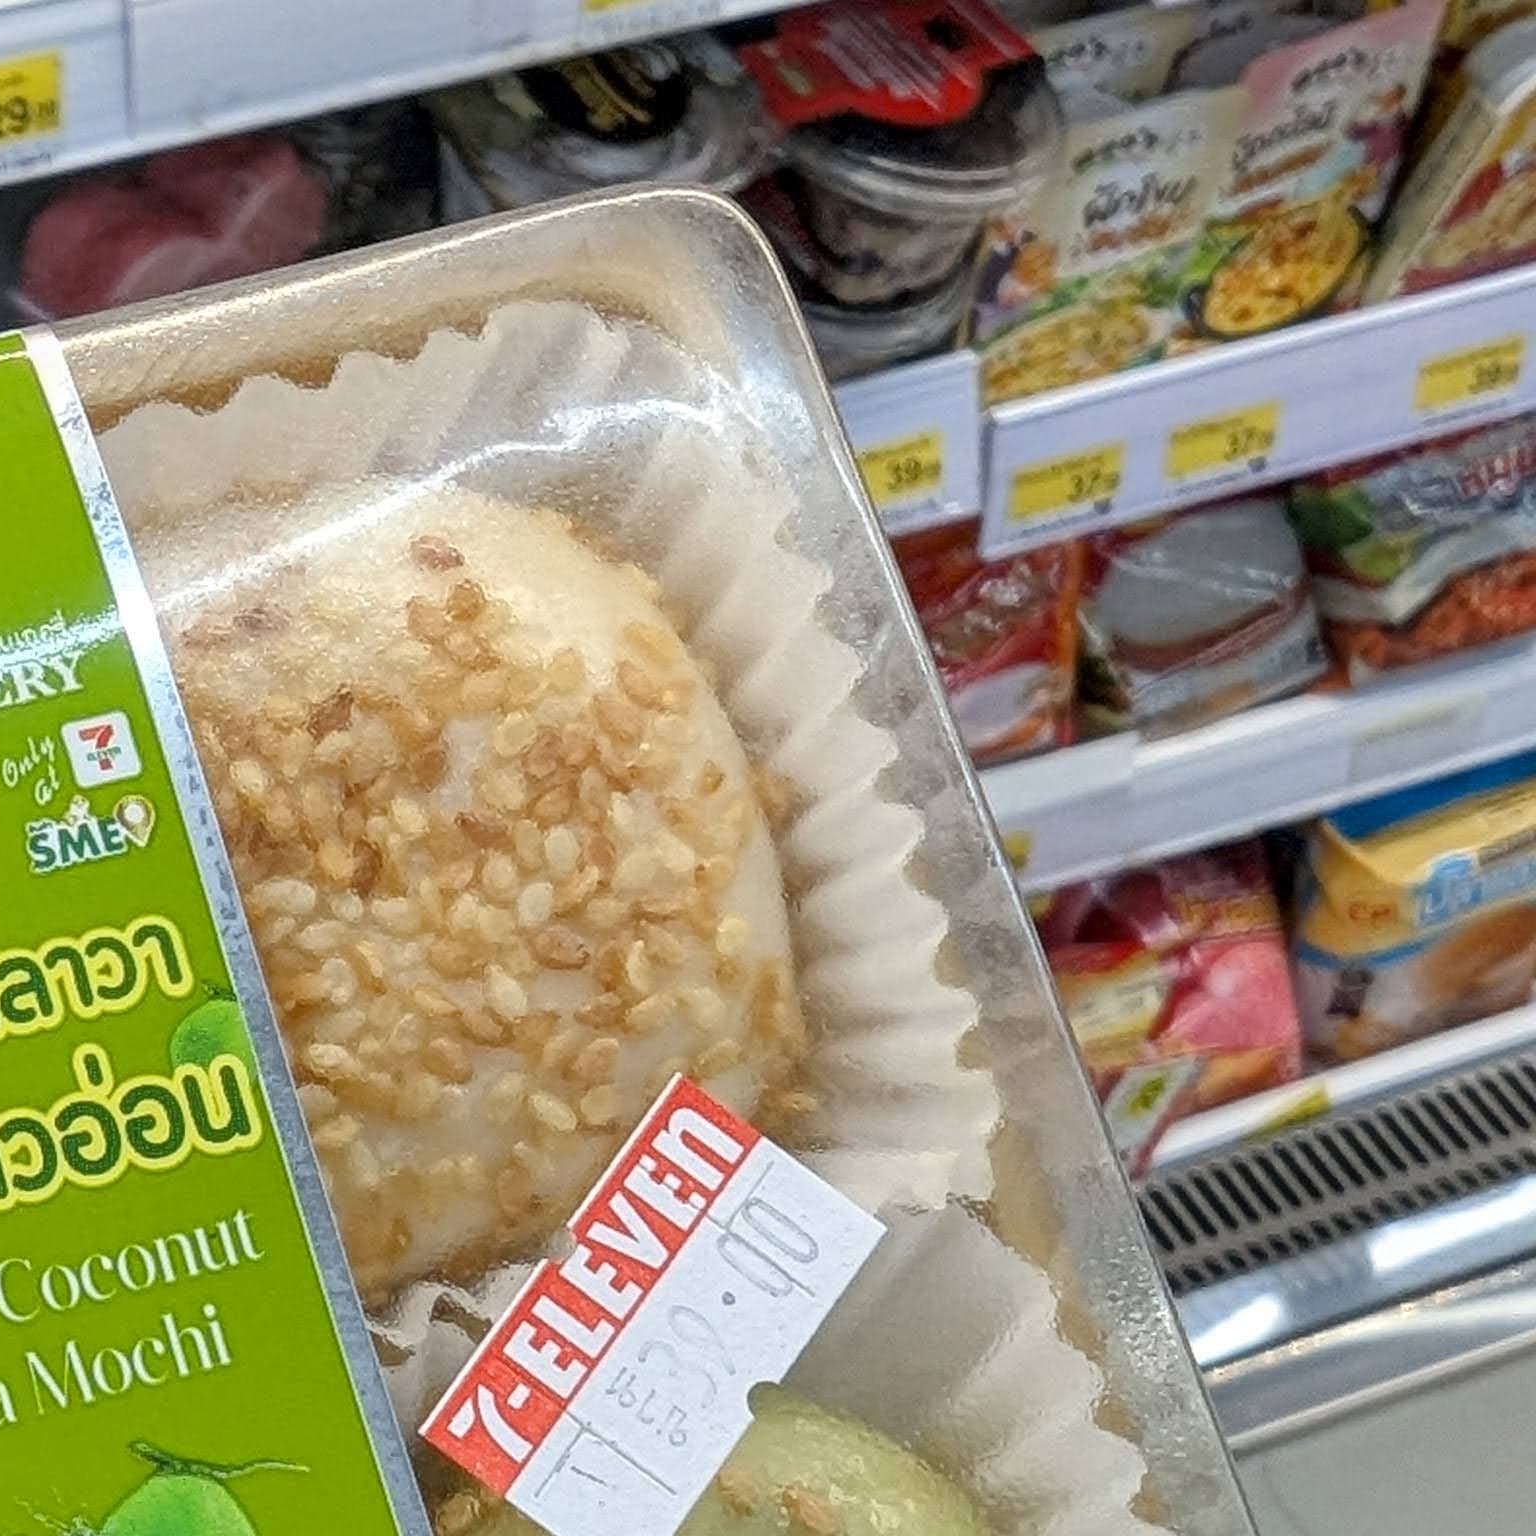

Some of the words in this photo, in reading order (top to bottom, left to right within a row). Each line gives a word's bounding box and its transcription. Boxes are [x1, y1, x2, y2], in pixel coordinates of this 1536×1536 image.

[1, 735, 55, 788] Only
[28, 816, 126, 870] SME
[23, 1303, 232, 1416] Mochi
